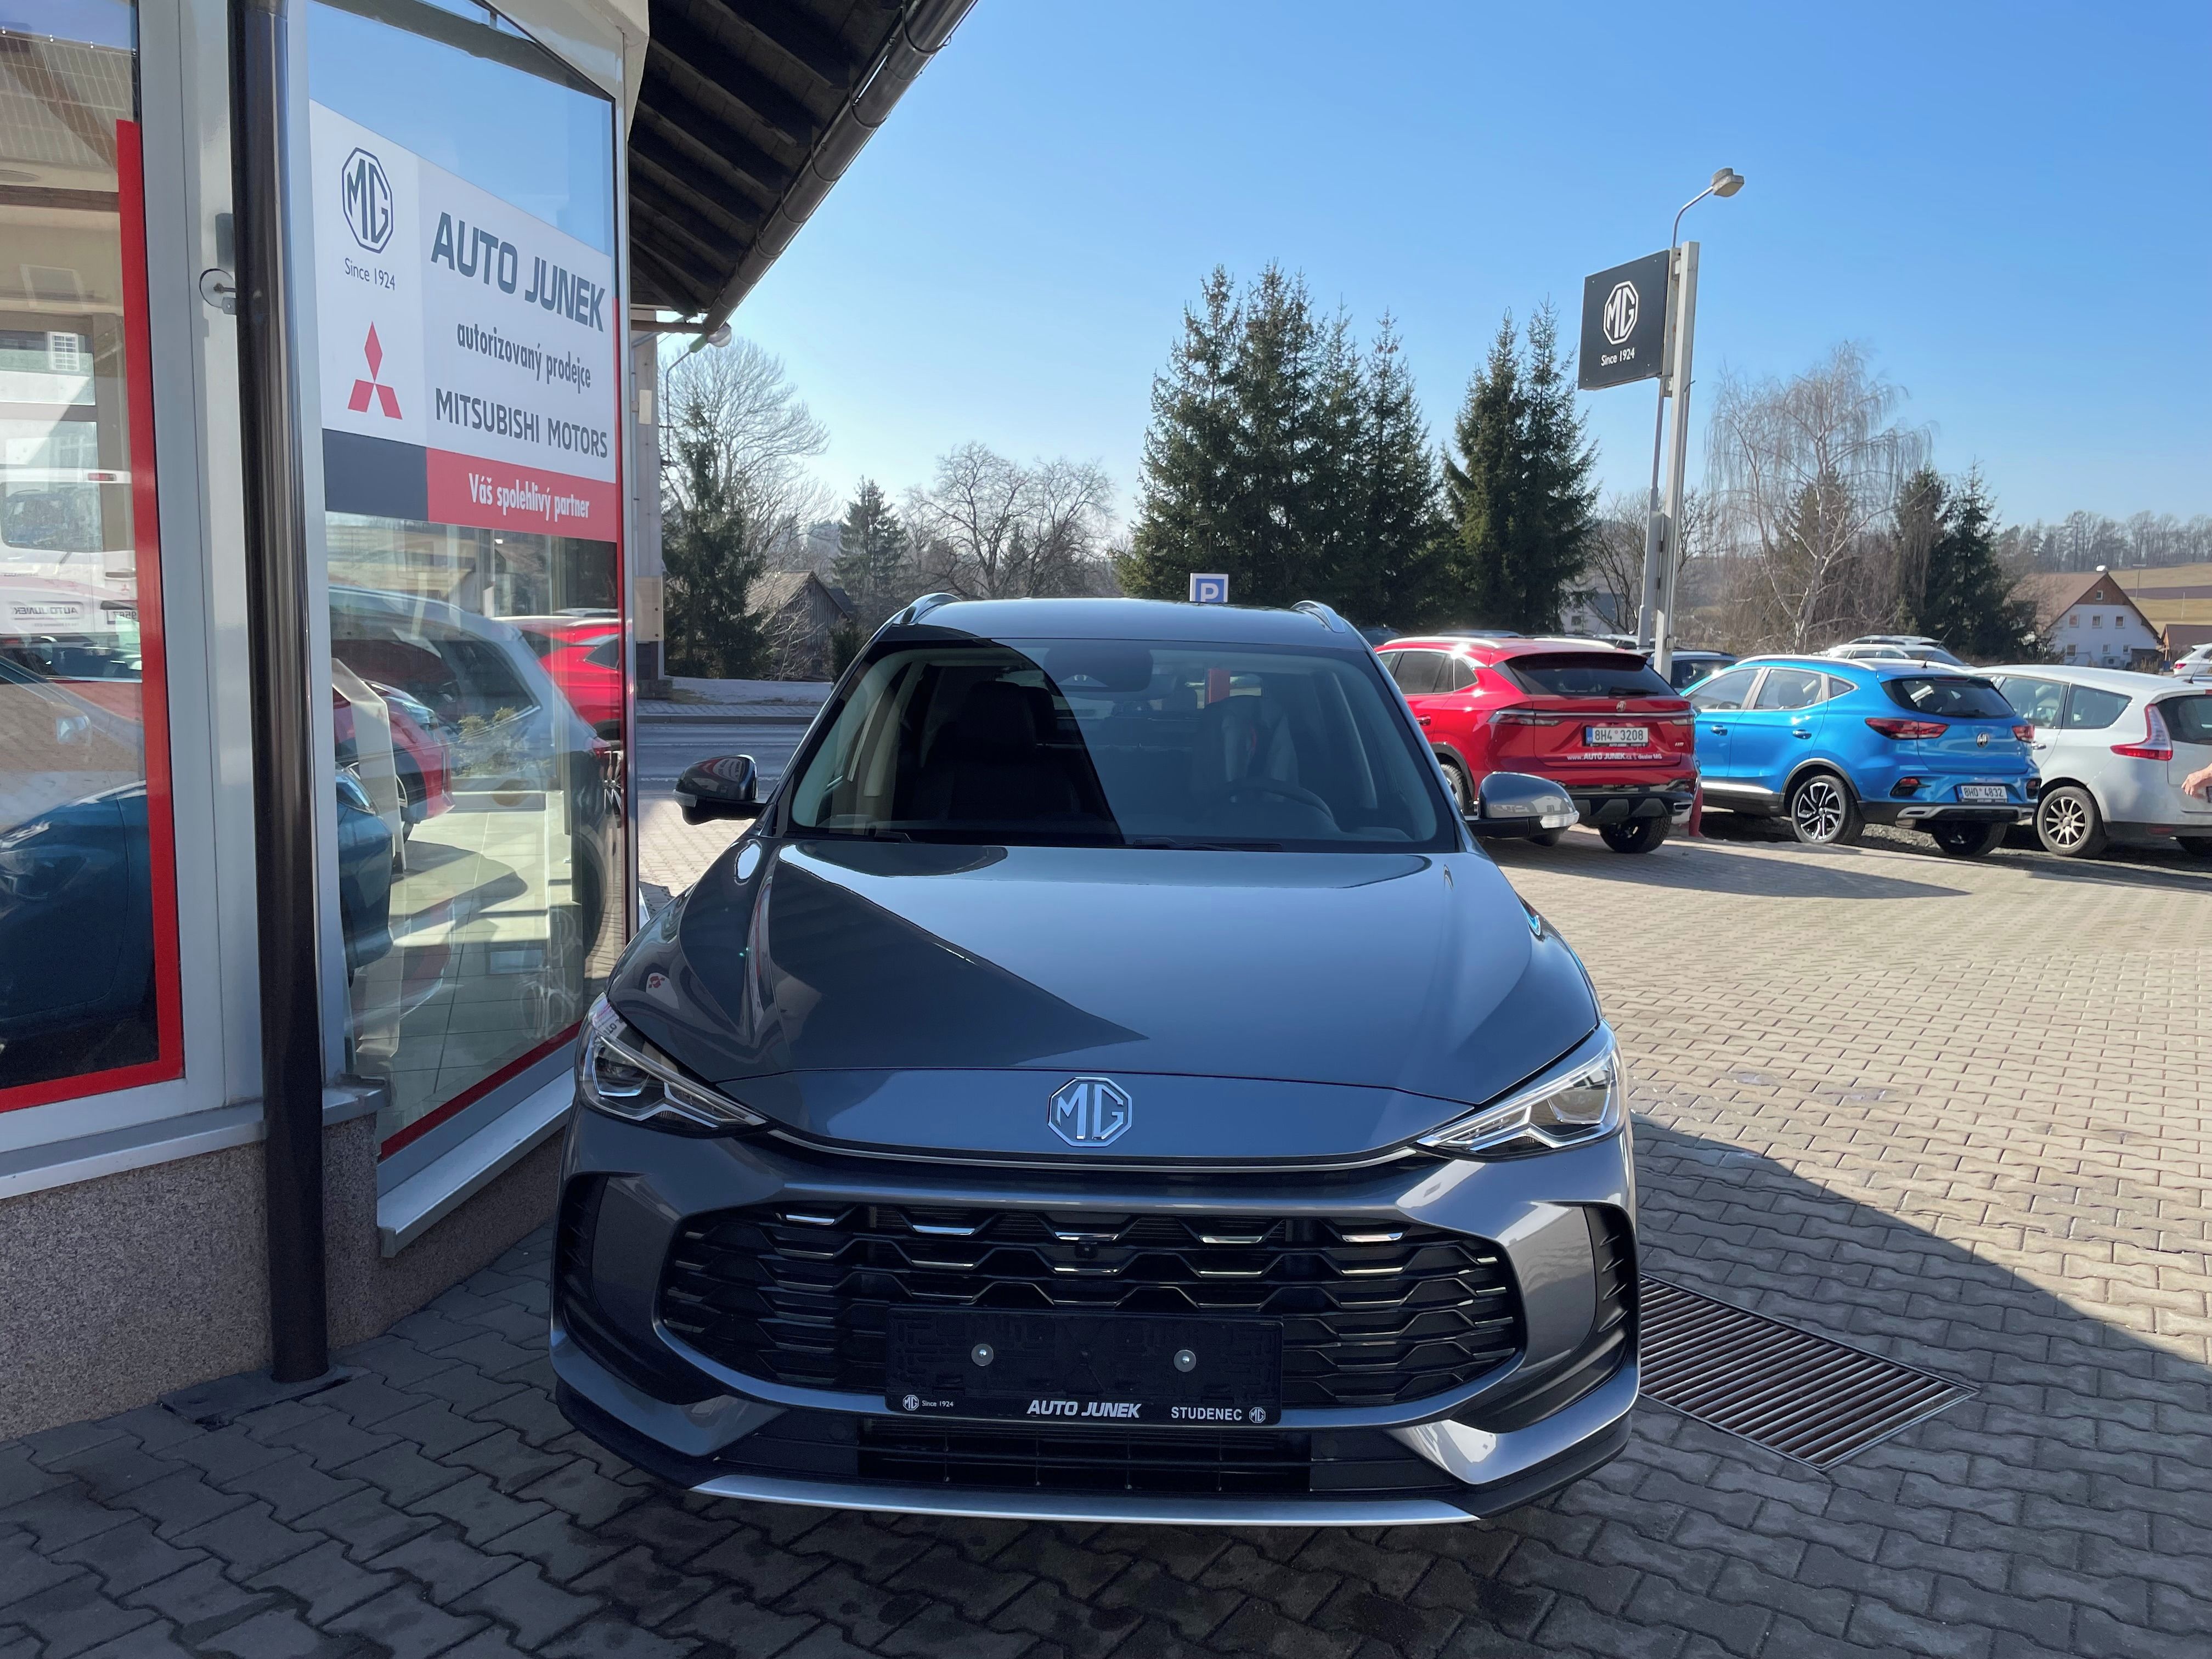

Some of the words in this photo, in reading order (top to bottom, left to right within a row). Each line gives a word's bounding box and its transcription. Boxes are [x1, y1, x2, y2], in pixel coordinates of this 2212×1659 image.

[347, 157, 389, 244] MG
[344, 257, 370, 283] Since
[374, 268, 396, 291] 1924
[431, 212, 517, 295] AUTO
[525, 256, 605, 332] JUNEK
[1606, 286, 1636, 338] MG
[457, 323, 542, 382] autorizovaný
[546, 351, 591, 394] prodejce
[1600, 353, 1617, 367] Since
[1619, 347, 1635, 363] 1924
[435, 387, 540, 443] MITSUBISHI
[548, 417, 608, 459] MOTORS
[469, 472, 493, 505] Váš
[496, 479, 551, 522] spolehlivý
[554, 494, 590, 523] partner
[1200, 583, 1219, 602] P
[1595, 729, 1613, 741] 8H4
[1620, 729, 1644, 741] 3208
[1984, 787, 2004, 798] 4832
[1056, 1083, 1124, 1140] MG
[903, 1395, 919, 1410] MG
[1026, 1400, 1079, 1416] AUTO
[1081, 1402, 1142, 1418] JUNEK
[1171, 1406, 1243, 1421] STUDENEC
[1249, 1407, 1266, 1424] MG
